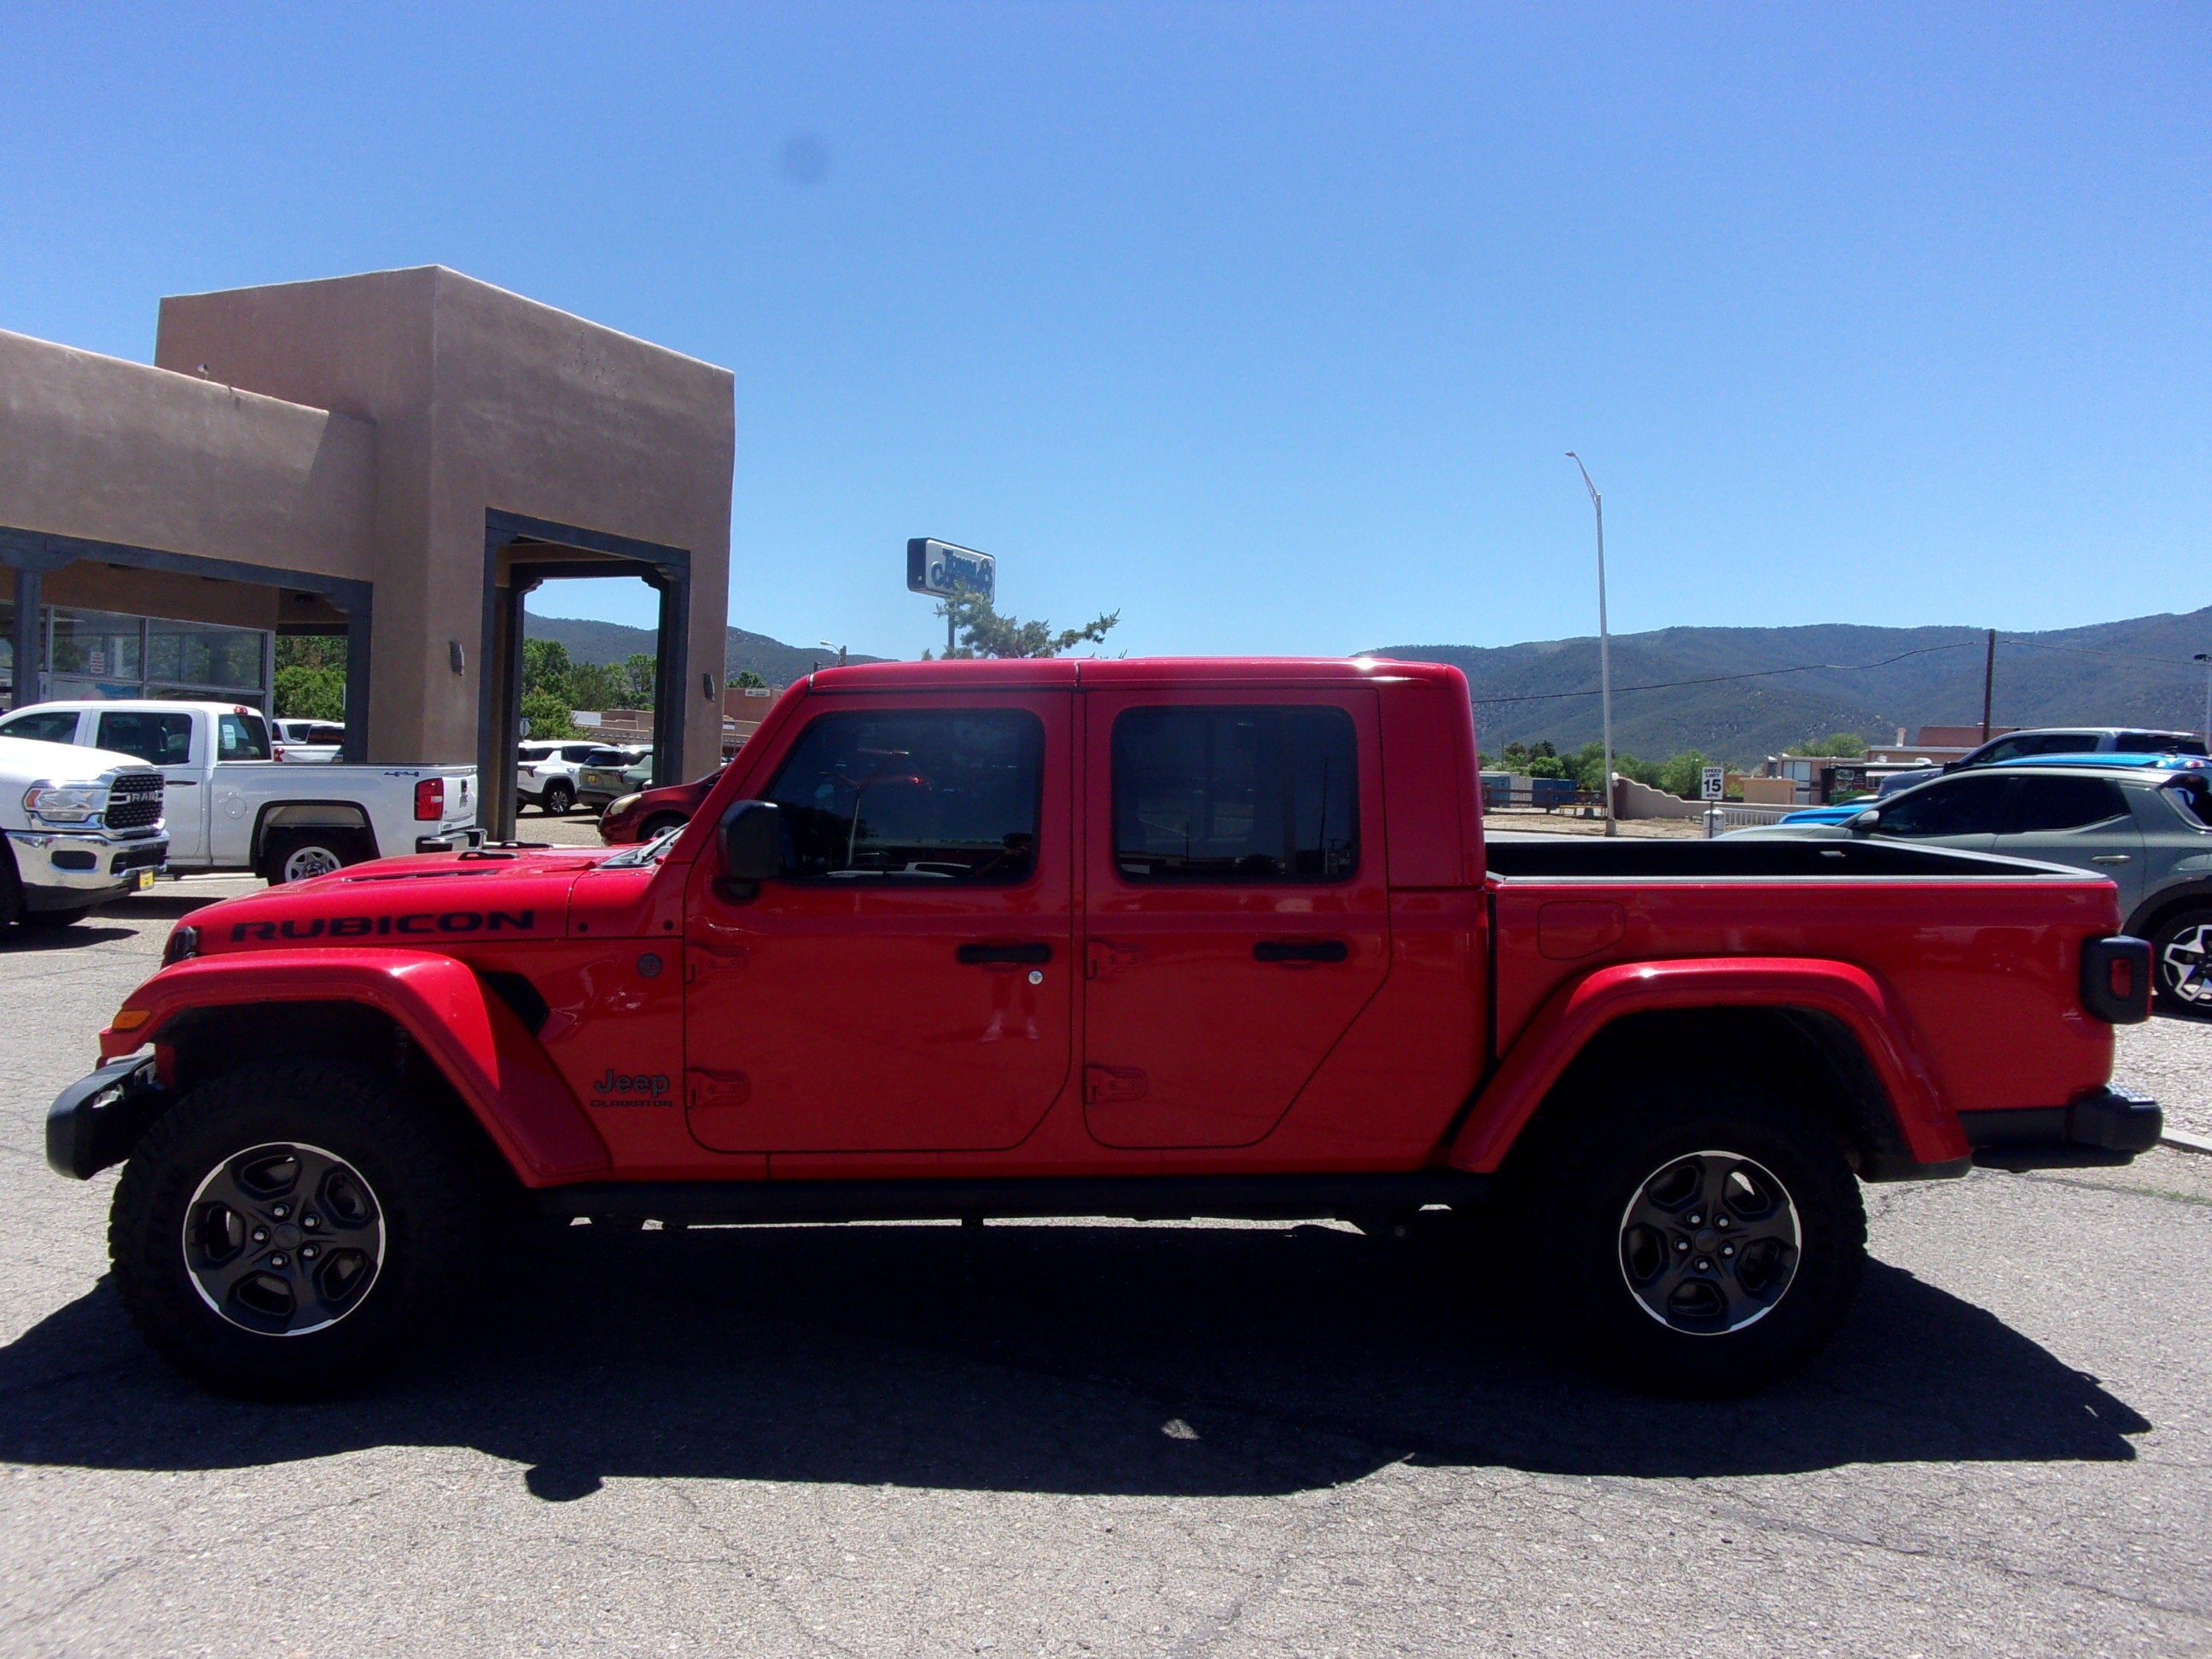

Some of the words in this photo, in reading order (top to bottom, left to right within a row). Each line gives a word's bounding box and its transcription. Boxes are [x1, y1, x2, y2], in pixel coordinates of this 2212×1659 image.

[1703, 778, 1722, 793] 15
[230, 910, 534, 943] RUBICON
[594, 1068, 670, 1099] Jeep
[590, 1099, 673, 1108] GLADIATOR
